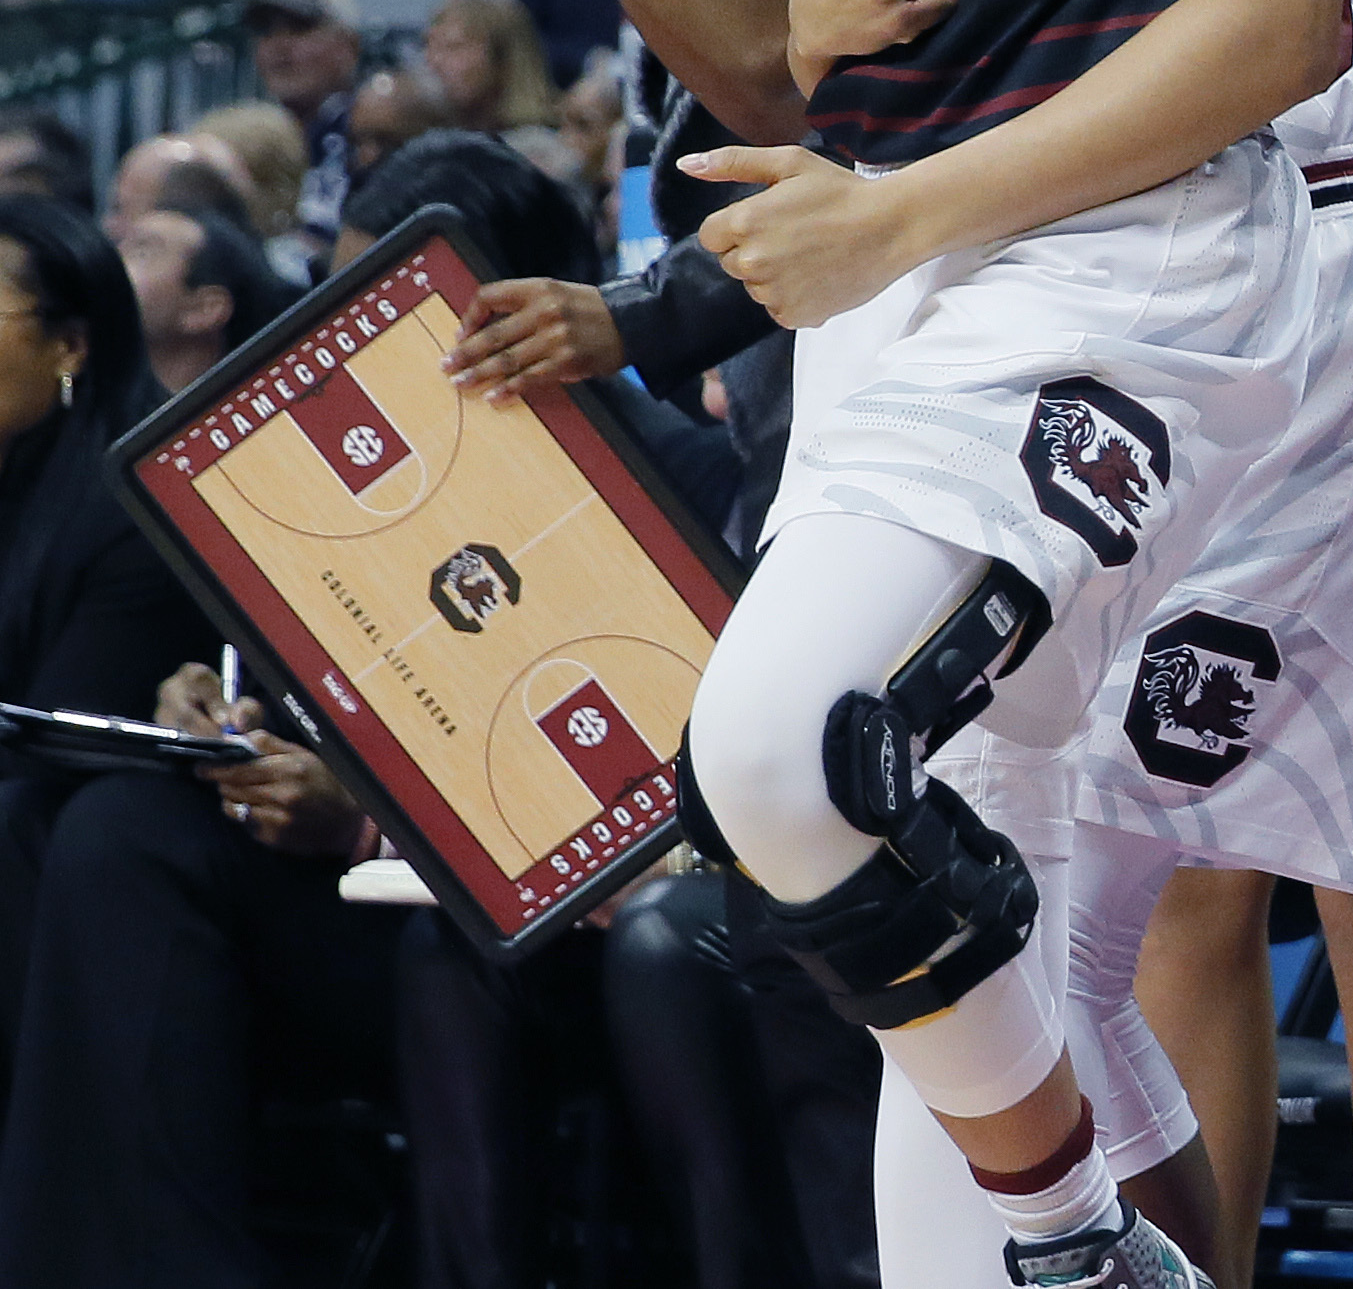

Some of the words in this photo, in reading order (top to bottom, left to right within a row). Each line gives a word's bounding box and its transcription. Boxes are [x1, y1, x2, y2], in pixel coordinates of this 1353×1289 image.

[209, 298, 398, 451] GAMECOCKS
[342, 425, 385, 467] SEC
[320, 569, 383, 645] COLONIAL
[383, 648, 415, 683] LIFE
[414, 687, 457, 736] ARENA
[568, 706, 609, 748] SEC
